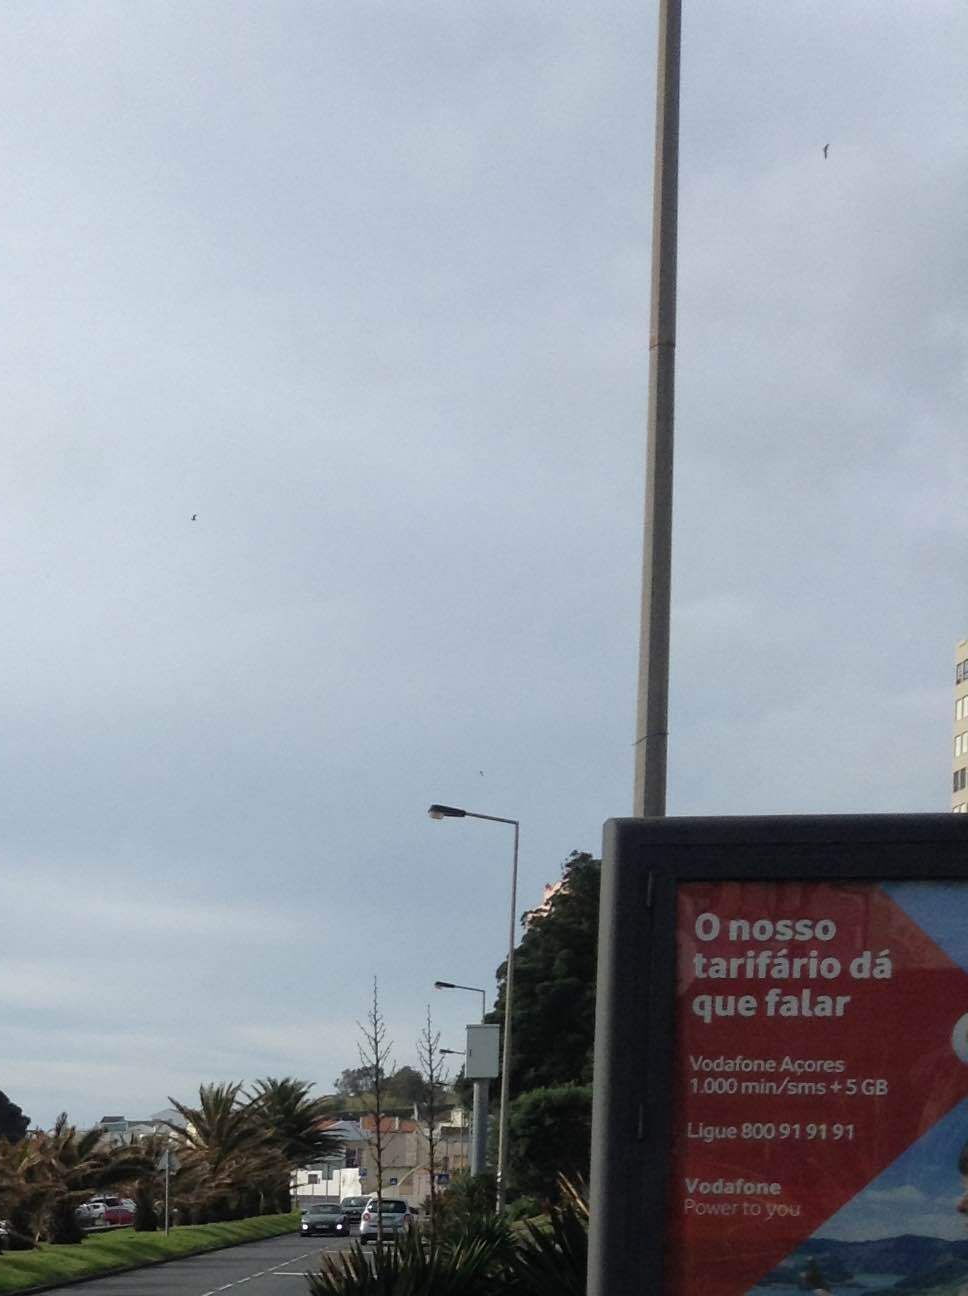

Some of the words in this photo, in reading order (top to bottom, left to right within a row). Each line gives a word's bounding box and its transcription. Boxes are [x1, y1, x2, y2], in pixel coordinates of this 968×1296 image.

[695, 912, 720, 942] O
[729, 919, 836, 942] nosso
[693, 949, 841, 980] tarifário
[849, 949, 892, 980] dá
[692, 994, 758, 1023] que
[765, 988, 851, 1017] falar
[690, 1055, 776, 1073] Vodafone
[780, 1056, 846, 1076] Açores
[690, 1078, 738, 1095] 1.000
[741, 1077, 826, 1096] min/sms
[845, 1079, 857, 1095] 5
[861, 1079, 889, 1096] GB
[687, 1122, 737, 1143] Ligue
[741, 1123, 776, 1140] 800
[779, 1123, 800, 1140] 91
[806, 1123, 827, 1140] 91
[832, 1123, 855, 1140] 91
[685, 1178, 782, 1195] Vodafone
[684, 1198, 738, 1216] Power
[743, 1201, 761, 1216] to
[765, 1203, 801, 1221] you
